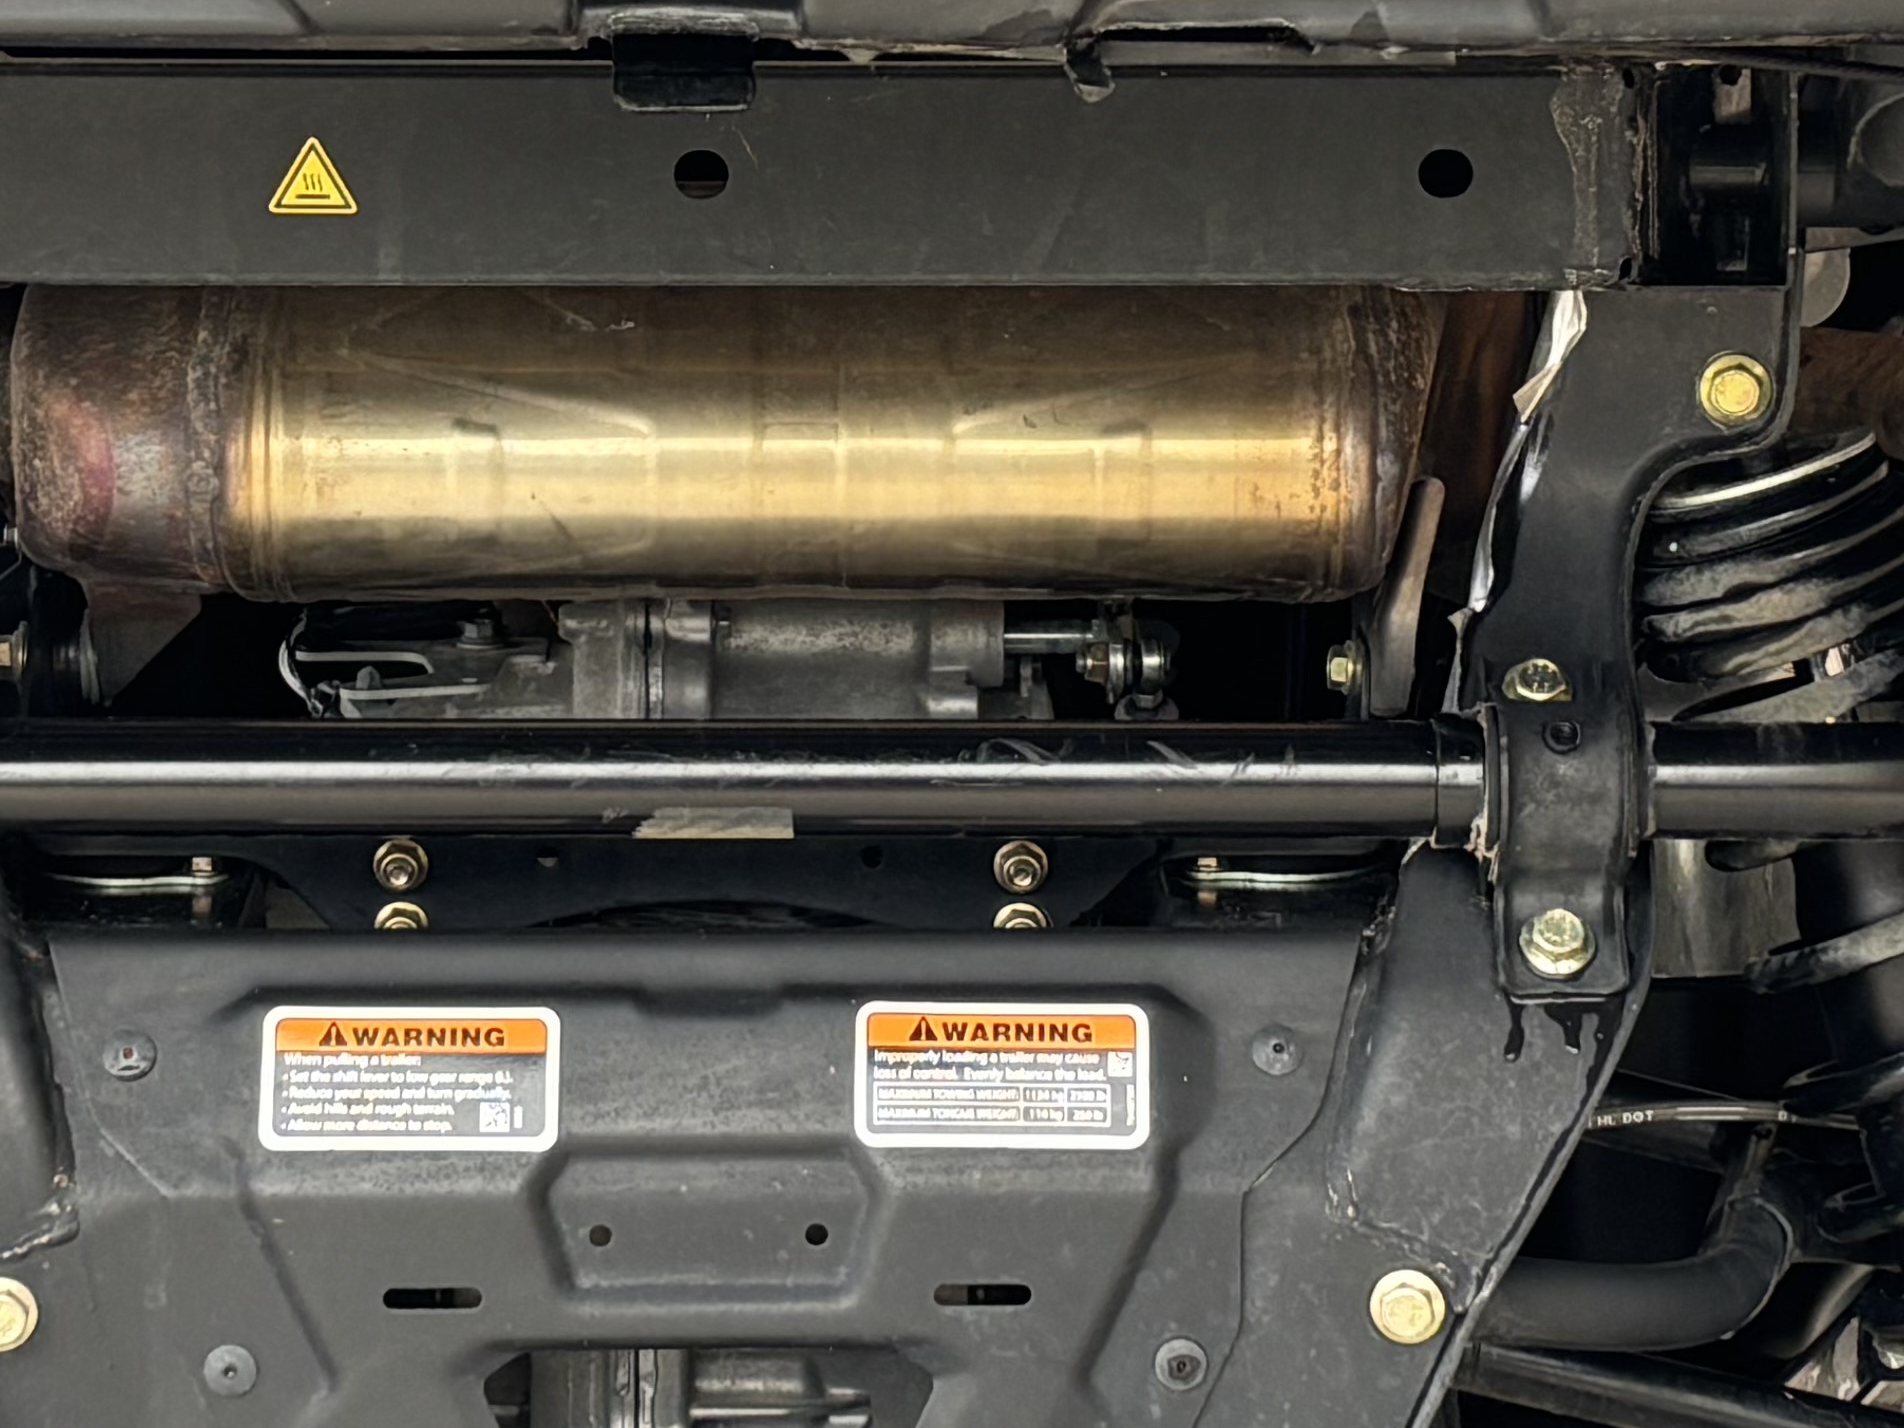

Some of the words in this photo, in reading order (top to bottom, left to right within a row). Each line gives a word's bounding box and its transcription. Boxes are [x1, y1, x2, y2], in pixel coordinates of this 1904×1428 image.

[352, 1026, 505, 1049] WARNING
[941, 1022, 1093, 1043] WARNING
[284, 1052, 322, 1066] When
[323, 1052, 369, 1069] pulling
[874, 1049, 941, 1065] Improperly
[942, 1050, 988, 1066] loading
[999, 1051, 1035, 1064] trailer
[1036, 1052, 1063, 1066] may
[1064, 1052, 1100, 1064] cause
[289, 1069, 309, 1083] Set
[310, 1070, 331, 1083] the
[332, 1070, 358, 1083] shift
[360, 1070, 390, 1083] lever
[405, 1070, 429, 1083] low
[429, 1072, 457, 1086] gear
[458, 1072, 494, 1086] range
[873, 1065, 897, 1080] loss
[963, 1067, 1004, 1082] Evenly
[1005, 1067, 1053, 1081] balance
[1054, 1067, 1076, 1081] the
[1077, 1068, 1107, 1081] load.
[289, 1085, 333, 1099] Reduce
[334, 1088, 362, 1101] your
[363, 1085, 401, 1101] speed
[401, 1086, 425, 1099] and
[426, 1087, 453, 1099] turn
[878, 1088, 932, 1100] MAXIMUM
[933, 1088, 975, 1100] TOWING
[287, 1102, 323, 1115] Avoid
[324, 1102, 348, 1115] hills
[349, 1102, 373, 1115] and
[375, 1102, 412, 1118] rough
[878, 1107, 931, 1119] MAXIMUM
[932, 1107, 975, 1119] TONGUE
[1622, 1109, 1654, 1123] DOT
[287, 1118, 322, 1131] Allow
[322, 1120, 356, 1131] more
[356, 1118, 407, 1131] distance
[423, 1119, 453, 1134] stop.
